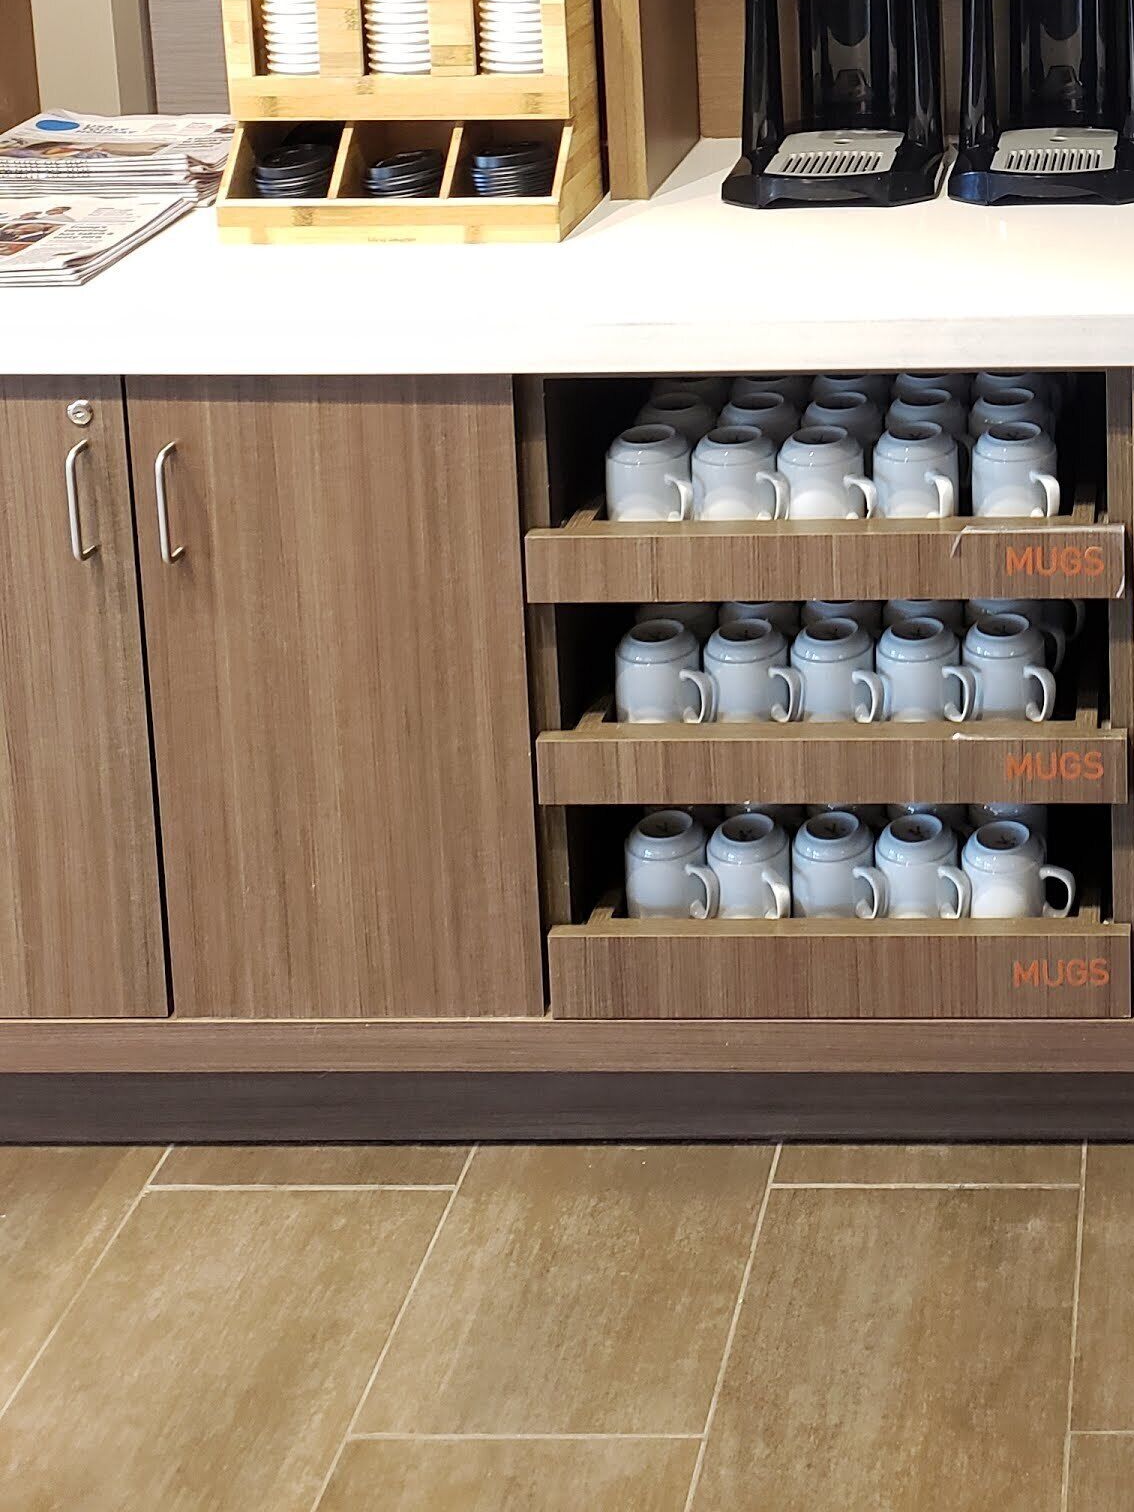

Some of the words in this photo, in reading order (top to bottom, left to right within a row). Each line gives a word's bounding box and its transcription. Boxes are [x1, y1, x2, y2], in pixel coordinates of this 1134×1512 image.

[1005, 546, 1105, 577] MUGS
[1006, 751, 1104, 781] MUGS
[1013, 958, 1110, 987] MUGS
